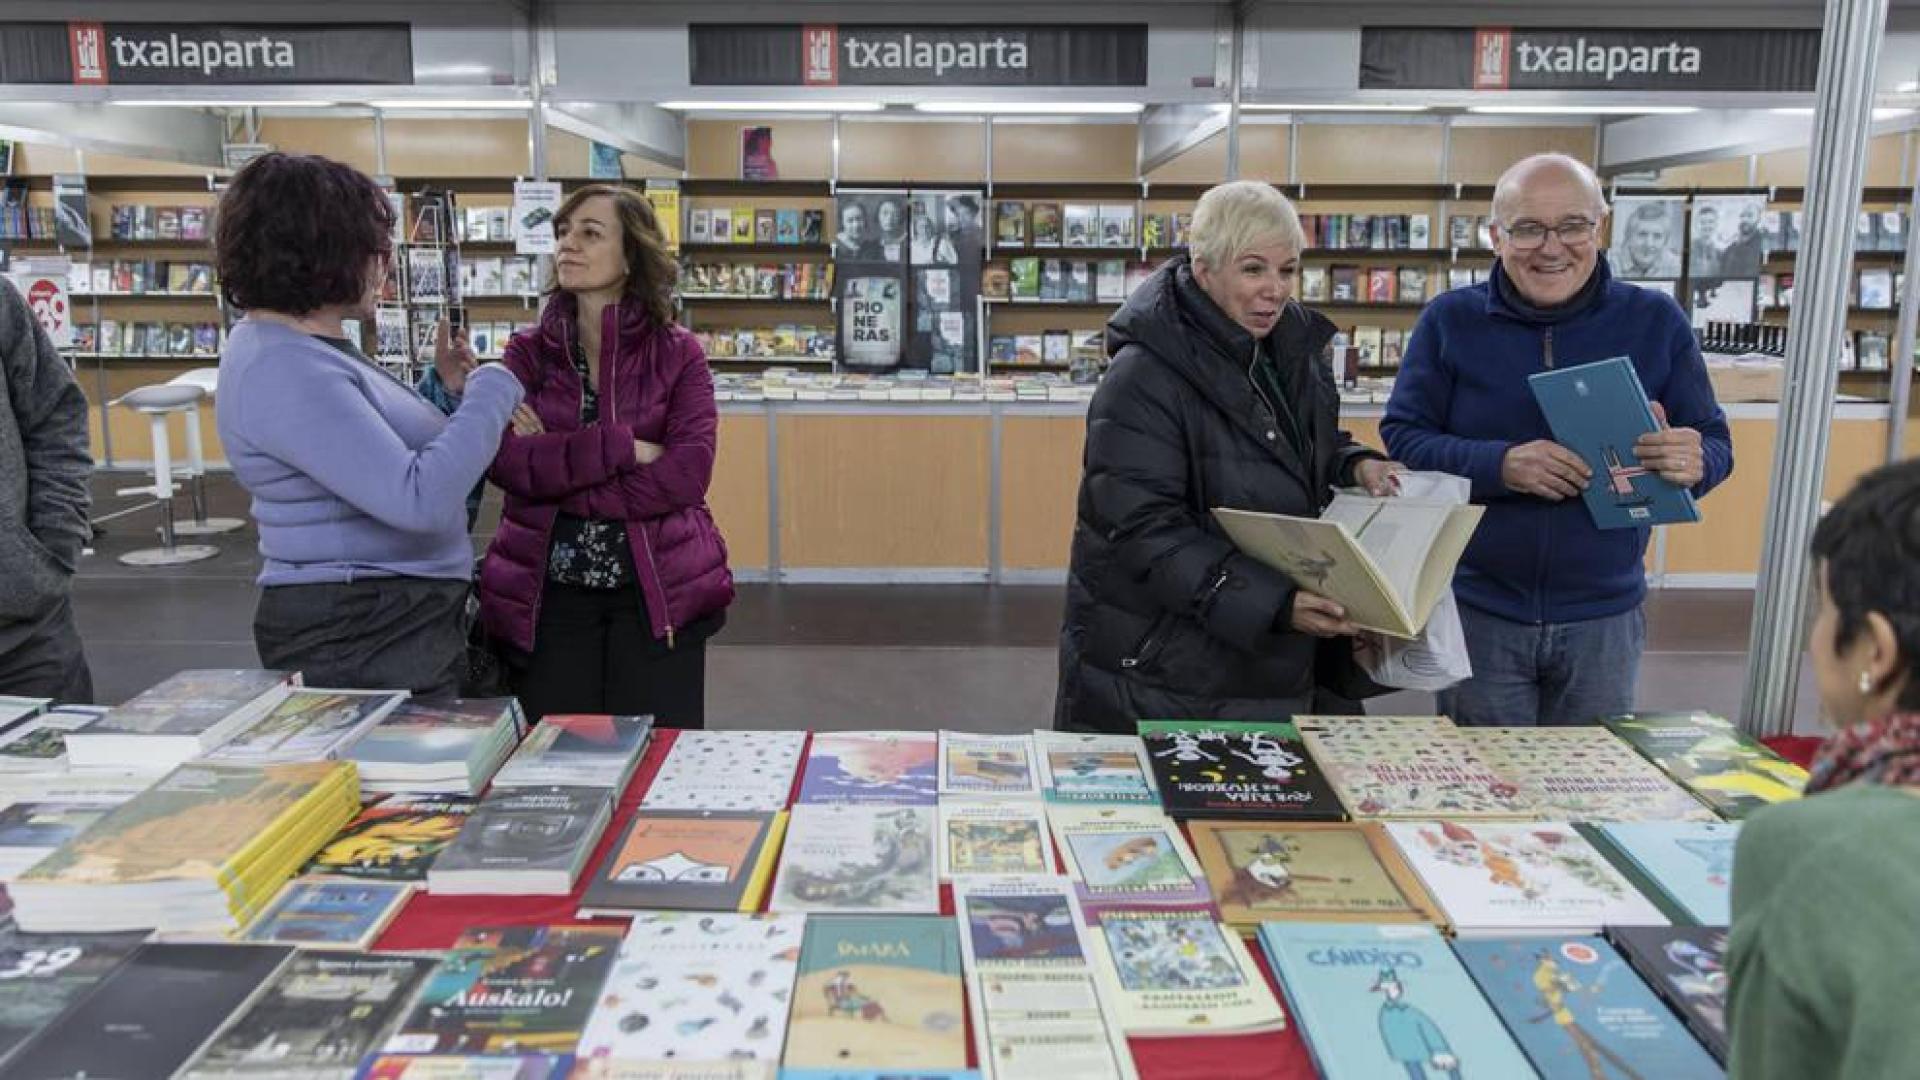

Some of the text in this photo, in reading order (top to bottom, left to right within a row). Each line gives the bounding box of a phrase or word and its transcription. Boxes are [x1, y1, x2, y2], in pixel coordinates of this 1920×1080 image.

[111, 33, 294, 75] txalaparta
[845, 34, 1028, 76] txalaparta
[1516, 38, 1700, 81] txalaparta
[853, 301, 884, 314] PIO
[853, 315, 877, 328] NE
[853, 329, 889, 342] RAS
[443, 986, 574, 1008] Auskalo!
